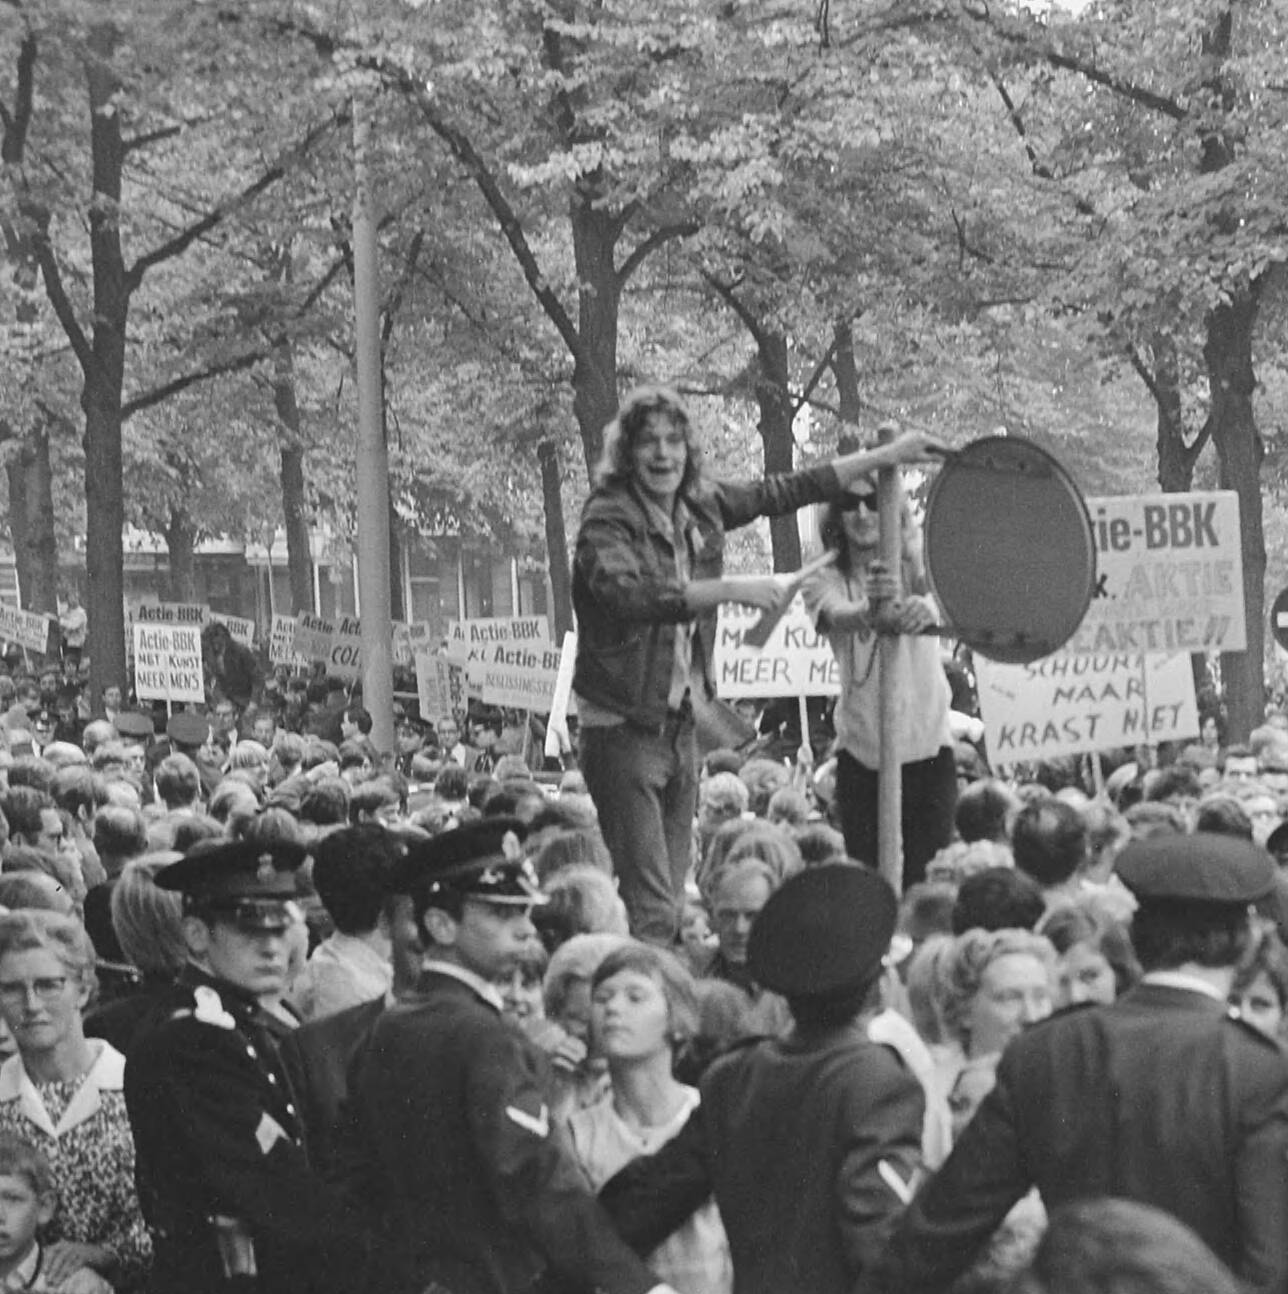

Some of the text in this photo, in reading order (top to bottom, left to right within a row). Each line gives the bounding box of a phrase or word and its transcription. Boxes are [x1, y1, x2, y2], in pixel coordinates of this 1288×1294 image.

[1092, 502, 1220, 552] ie-BBK
[1124, 559, 1233, 599] AKTIE
[722, 658, 840, 685] MEER ME
[1053, 677, 1144, 706] MAAR
[998, 712, 1101, 750] KRAST
